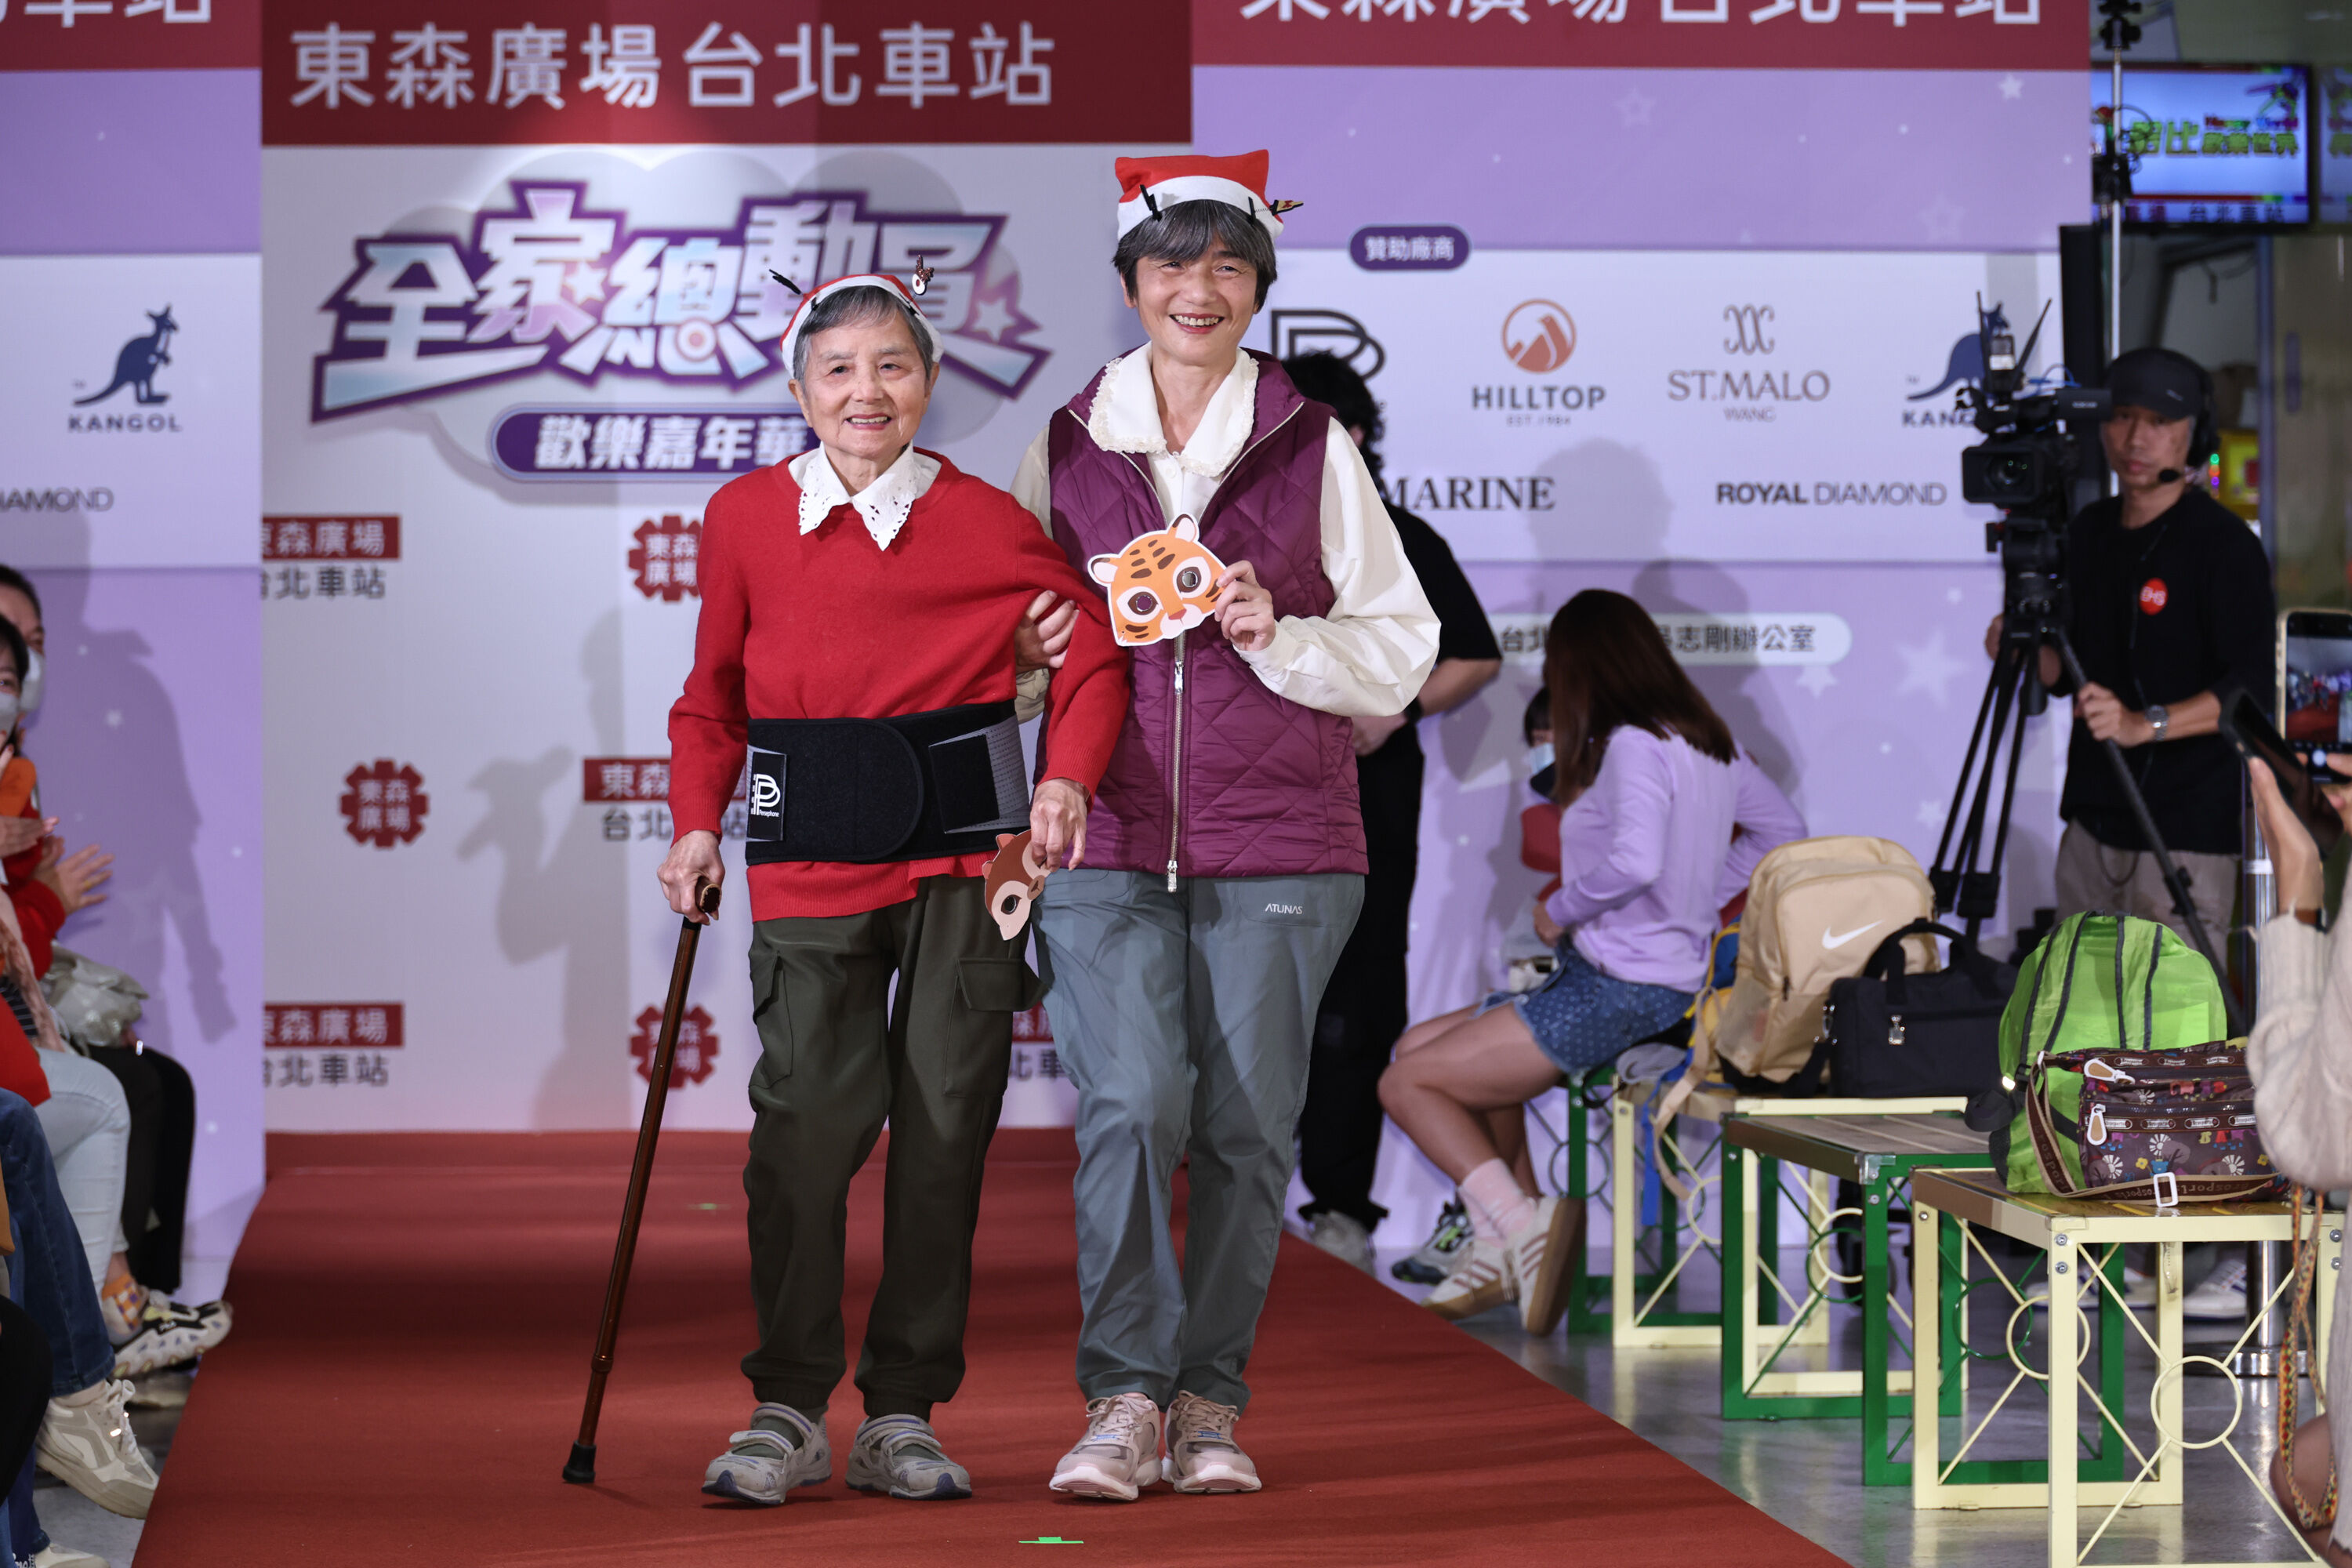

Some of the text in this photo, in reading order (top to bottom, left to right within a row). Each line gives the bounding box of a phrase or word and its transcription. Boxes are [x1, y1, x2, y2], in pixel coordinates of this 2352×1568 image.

[290, 22, 1054, 109] 東森廣場台北車站
[315, 183, 1049, 422] 全家總動員
[1667, 369, 1831, 401] ST.MALO
[1471, 386, 1607, 411] HILLTOP
[68, 414, 181, 432] KANGOL
[1902, 409, 1976, 427] KANG
[534, 416, 808, 470] 歡樂嘉年華
[0, 487, 114, 512] IAMOND
[1716, 483, 1947, 506] ROYAL DIAMOND
[759, 808, 779, 817] Persephone
[1265, 902, 1303, 915] ATUNAS
